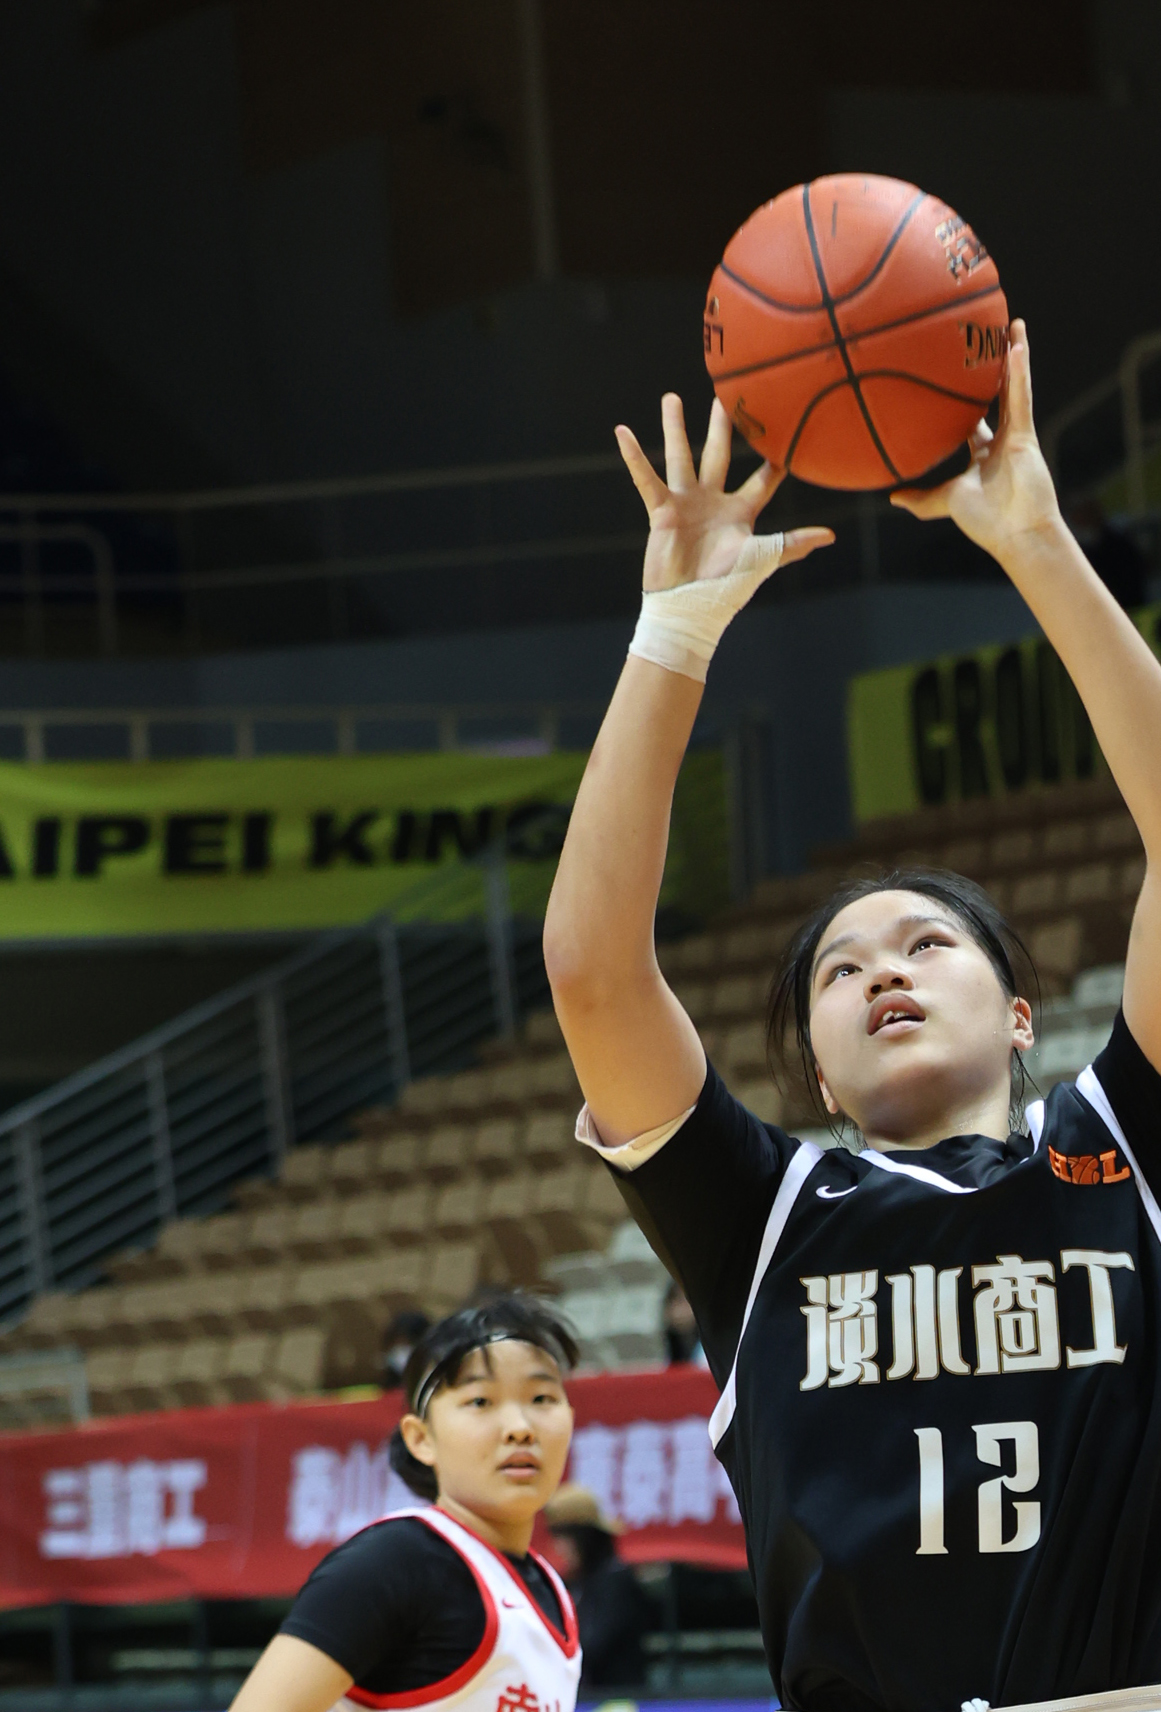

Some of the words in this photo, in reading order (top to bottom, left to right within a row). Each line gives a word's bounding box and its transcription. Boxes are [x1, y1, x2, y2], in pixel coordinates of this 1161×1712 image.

[800, 1250, 1135, 1391] 淡水商工
[913, 1421, 1042, 1555] 12
